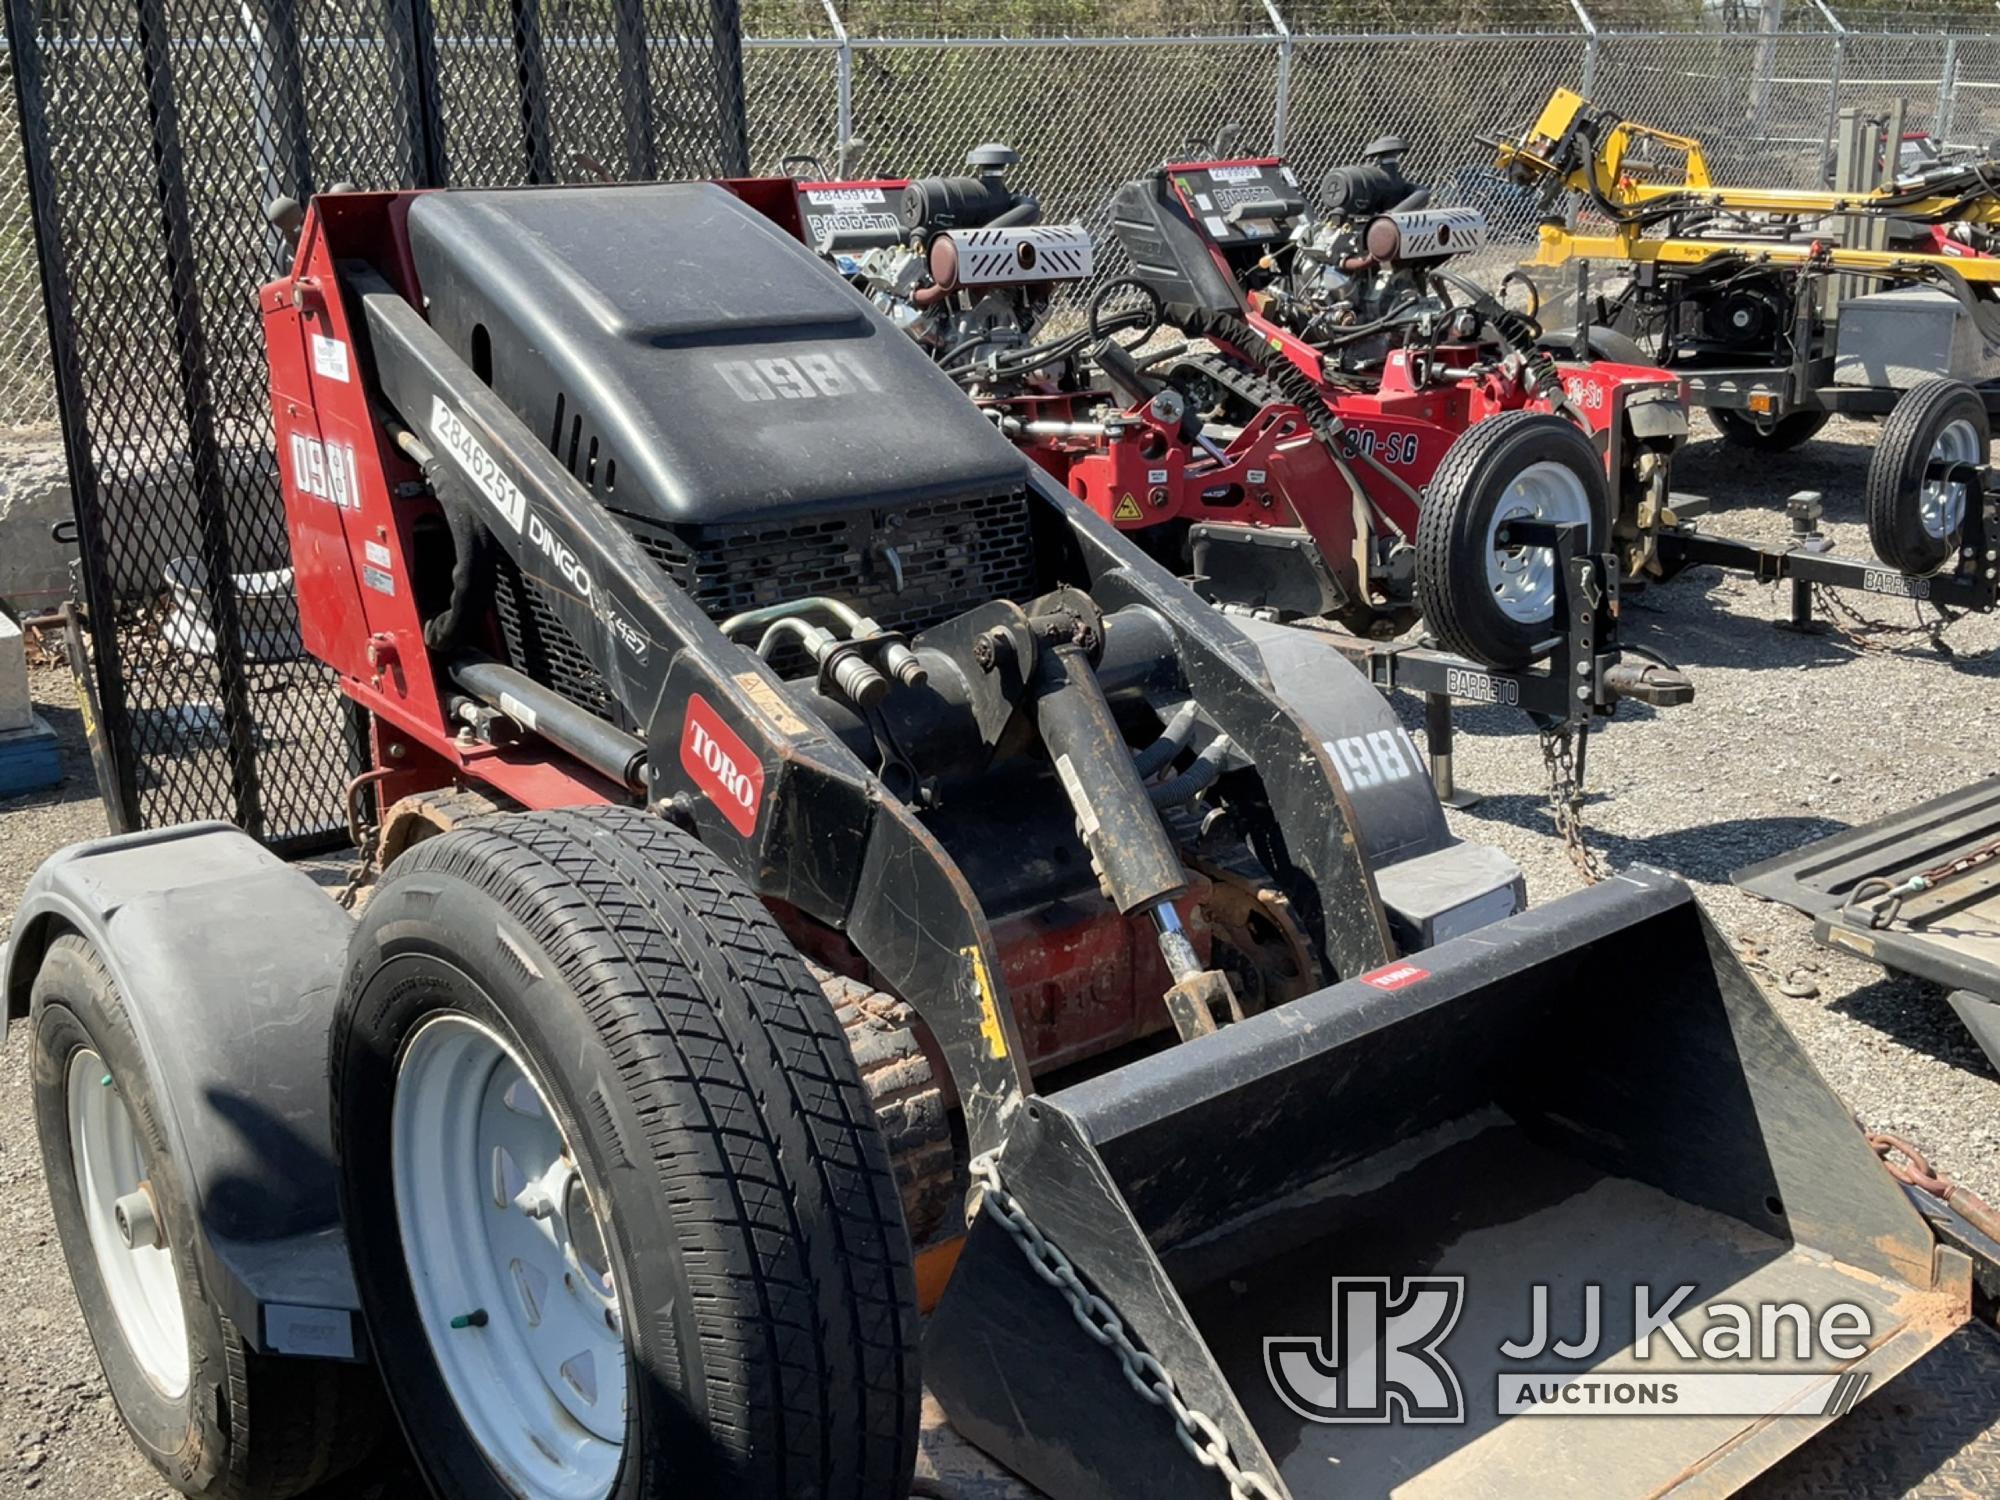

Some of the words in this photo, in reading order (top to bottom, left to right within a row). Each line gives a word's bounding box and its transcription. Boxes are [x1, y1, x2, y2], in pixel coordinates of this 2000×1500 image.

[713, 350, 884, 402] 0981
[291, 432, 361, 511] 0981
[440, 406, 518, 515] 2846251
[528, 513, 592, 596] DINGO
[1863, 569, 1930, 599] BARRETO
[1447, 668, 1519, 706] BARRETO
[690, 719, 754, 808] TORO
